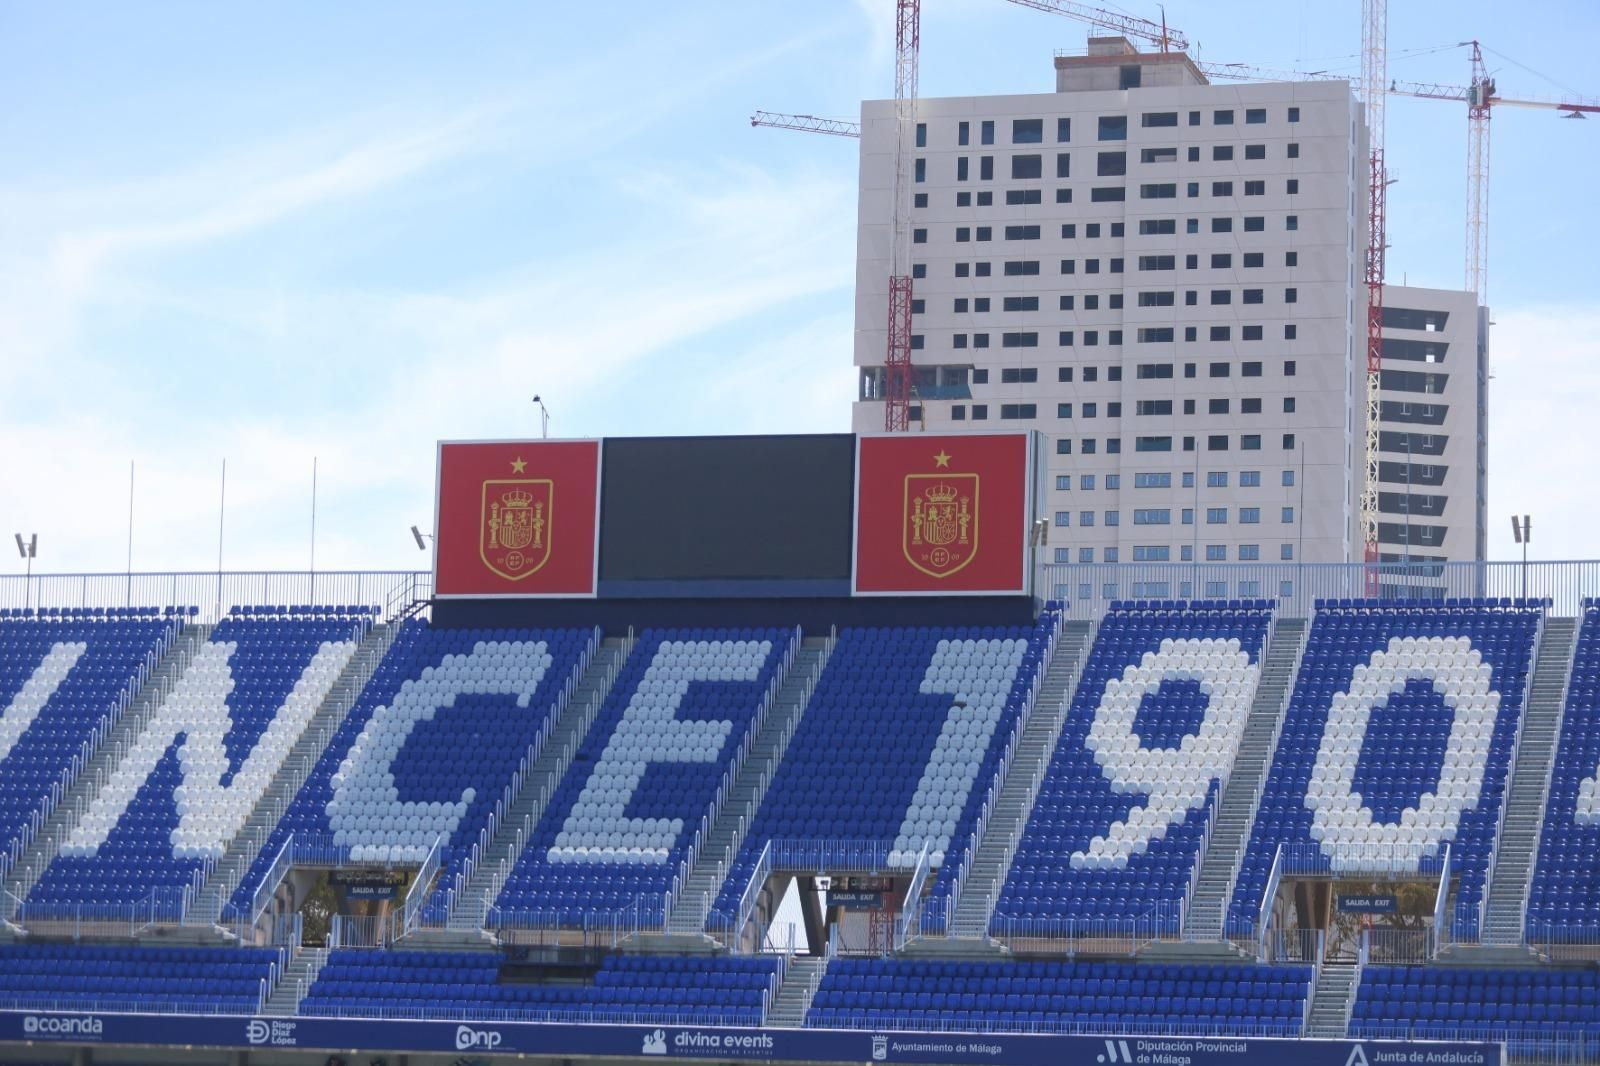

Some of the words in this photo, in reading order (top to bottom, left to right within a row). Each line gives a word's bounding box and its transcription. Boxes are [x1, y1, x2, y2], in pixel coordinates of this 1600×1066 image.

[885, 636, 1600, 870] 190
[352, 886, 374, 894] SALIDA
[38, 1015, 103, 1033] coanda
[272, 1020, 296, 1030] Diego
[271, 1036, 296, 1045] López
[456, 1028, 502, 1050] anp
[674, 1031, 720, 1046] divina
[723, 1033, 774, 1048] events
[891, 1041, 954, 1053] Ayuntamiento
[955, 1043, 967, 1053] de
[969, 1043, 1002, 1055] Málaga
[1137, 1040, 1193, 1052] Diputación
[1195, 1041, 1247, 1053] Provincial
[1137, 1053, 1150, 1063] de
[1152, 1053, 1191, 1066] Málaga
[1373, 1051, 1407, 1062] Junta
[1409, 1051, 1424, 1063] de
[1425, 1051, 1484, 1064] Andalucía
